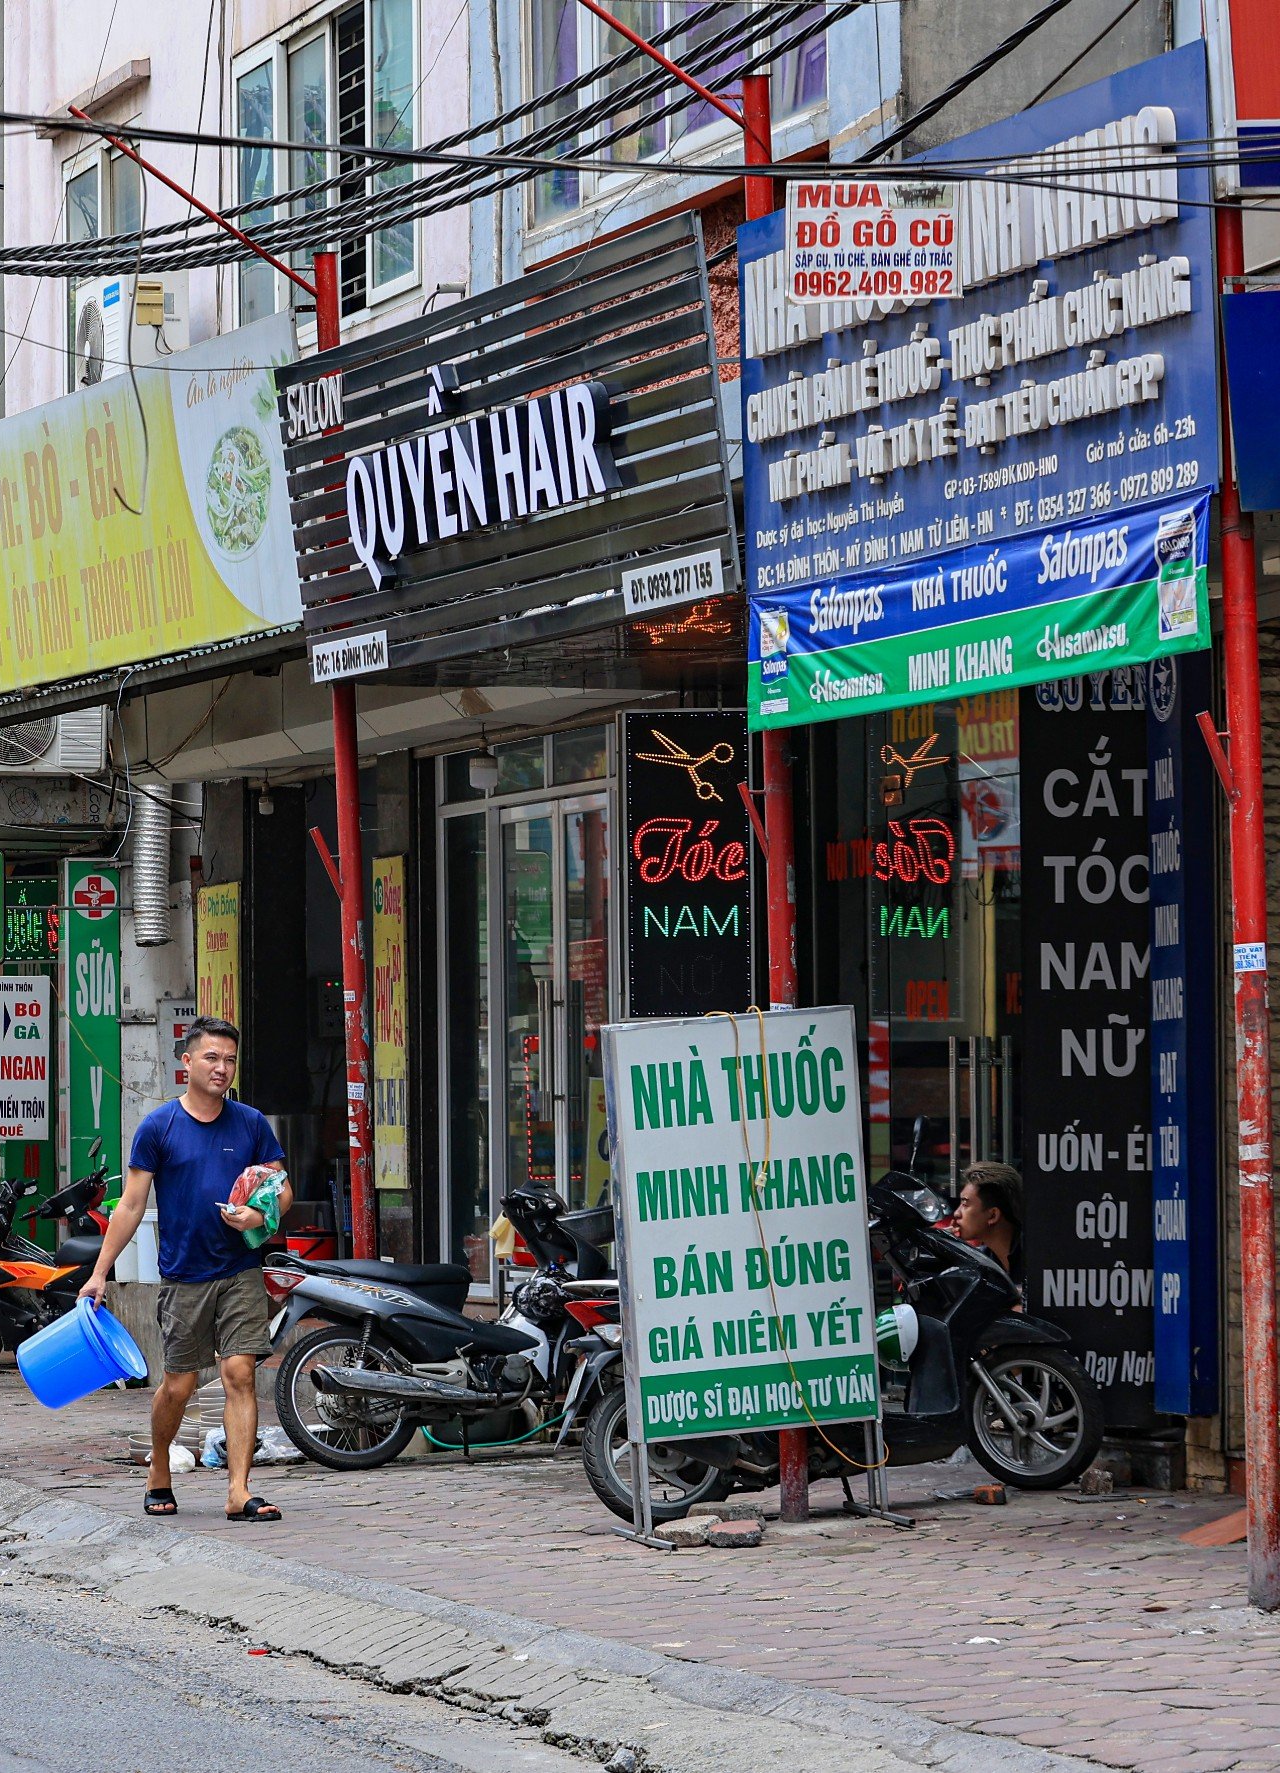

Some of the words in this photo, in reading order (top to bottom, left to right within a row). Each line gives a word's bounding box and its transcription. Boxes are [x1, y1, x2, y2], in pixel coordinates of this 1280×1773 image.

[798, 184, 882, 208] MUA
[796, 211, 840, 248] ĐỒ
[853, 210, 896, 247] GỖ
[910, 213, 953, 247] CŨ
[794, 270, 953, 297] 0962.409.982
[795, 251, 813, 271] SẬP
[834, 249, 845, 267] TỦ
[872, 250, 891, 268] BÀN
[893, 249, 911, 268] GHẾ
[914, 247, 927, 267] GỖ
[930, 247, 953, 267] TRẮC
[286, 374, 344, 439] SALON
[23, 420, 62, 541] BÒ
[86, 402, 127, 522] GÀ
[346, 364, 489, 592] QUYỀN
[489, 381, 607, 523] HAIR
[757, 530, 778, 550] Dược
[791, 521, 804, 541] đại
[807, 519, 825, 541] học:
[827, 503, 859, 532] Nguyễn
[861, 501, 875, 524] Thị
[877, 491, 905, 520] Huyền
[630, 575, 646, 604] ĐT:
[647, 575, 671, 599] 0932
[673, 569, 691, 594] 277
[693, 566, 713, 591] 155
[809, 584, 885, 635] Salonpas
[911, 566, 946, 613] NHÀ
[951, 548, 1008, 604] THUỐC
[1038, 525, 1129, 584] Salonpas
[315, 650, 328, 677] ĐC:
[331, 650, 341, 674] 16
[341, 643, 361, 672] ĐÌNH
[362, 635, 385, 666] THÔN
[763, 659, 787, 676] Salonpas
[809, 669, 884, 704] Hisamitsu
[909, 648, 950, 692] MINH
[956, 636, 1013, 684] KHANG
[1037, 622, 1129, 662] Hisamitsu
[1042, 736, 1148, 818] CẮT
[1151, 815, 1181, 875] THUỐC
[1042, 838, 1150, 904] TÓC
[206, 929, 229, 950] Chuyên:
[644, 905, 738, 938] NAM
[1155, 904, 1180, 949] MINH
[15, 981, 33, 992] THÔN
[75, 939, 116, 1018] SỮA
[1040, 942, 1151, 991] NAM
[14, 998, 41, 1017] BÒ
[905, 978, 950, 1023] OPEN
[1152, 977, 1183, 1022] KHANG
[14, 1021, 41, 1040] GÀ
[1061, 1014, 1146, 1079] NỮ
[0, 1055, 46, 1082] NGAN
[631, 1045, 714, 1130] NHÀ
[721, 1025, 846, 1123] THUỐC
[1160, 1051, 1177, 1102] ĐẠT
[20, 1096, 45, 1122] TRỘN
[1159, 1116, 1180, 1167] TIÊU
[636, 1163, 728, 1221] MINH
[740, 1153, 857, 1213] KHANG
[1155, 1182, 1187, 1242] CHUẨN
[1076, 1192, 1128, 1248] GỘI
[653, 1244, 734, 1299] BÁN
[745, 1236, 852, 1291] ĐÚNG
[1043, 1261, 1154, 1316] NHUỘM
[1161, 1272, 1181, 1315] GPP
[649, 1317, 703, 1364] GIÁ
[713, 1309, 798, 1357] NIÊM
[808, 1297, 863, 1348] YẾT
[648, 1387, 699, 1428] DƯỢC
[704, 1382, 724, 1418] SĨ
[728, 1385, 762, 1422] ĐẠI
[765, 1380, 804, 1419] HỌC
[808, 1373, 832, 1408] TƯ
[835, 1363, 874, 1404] VẤN
